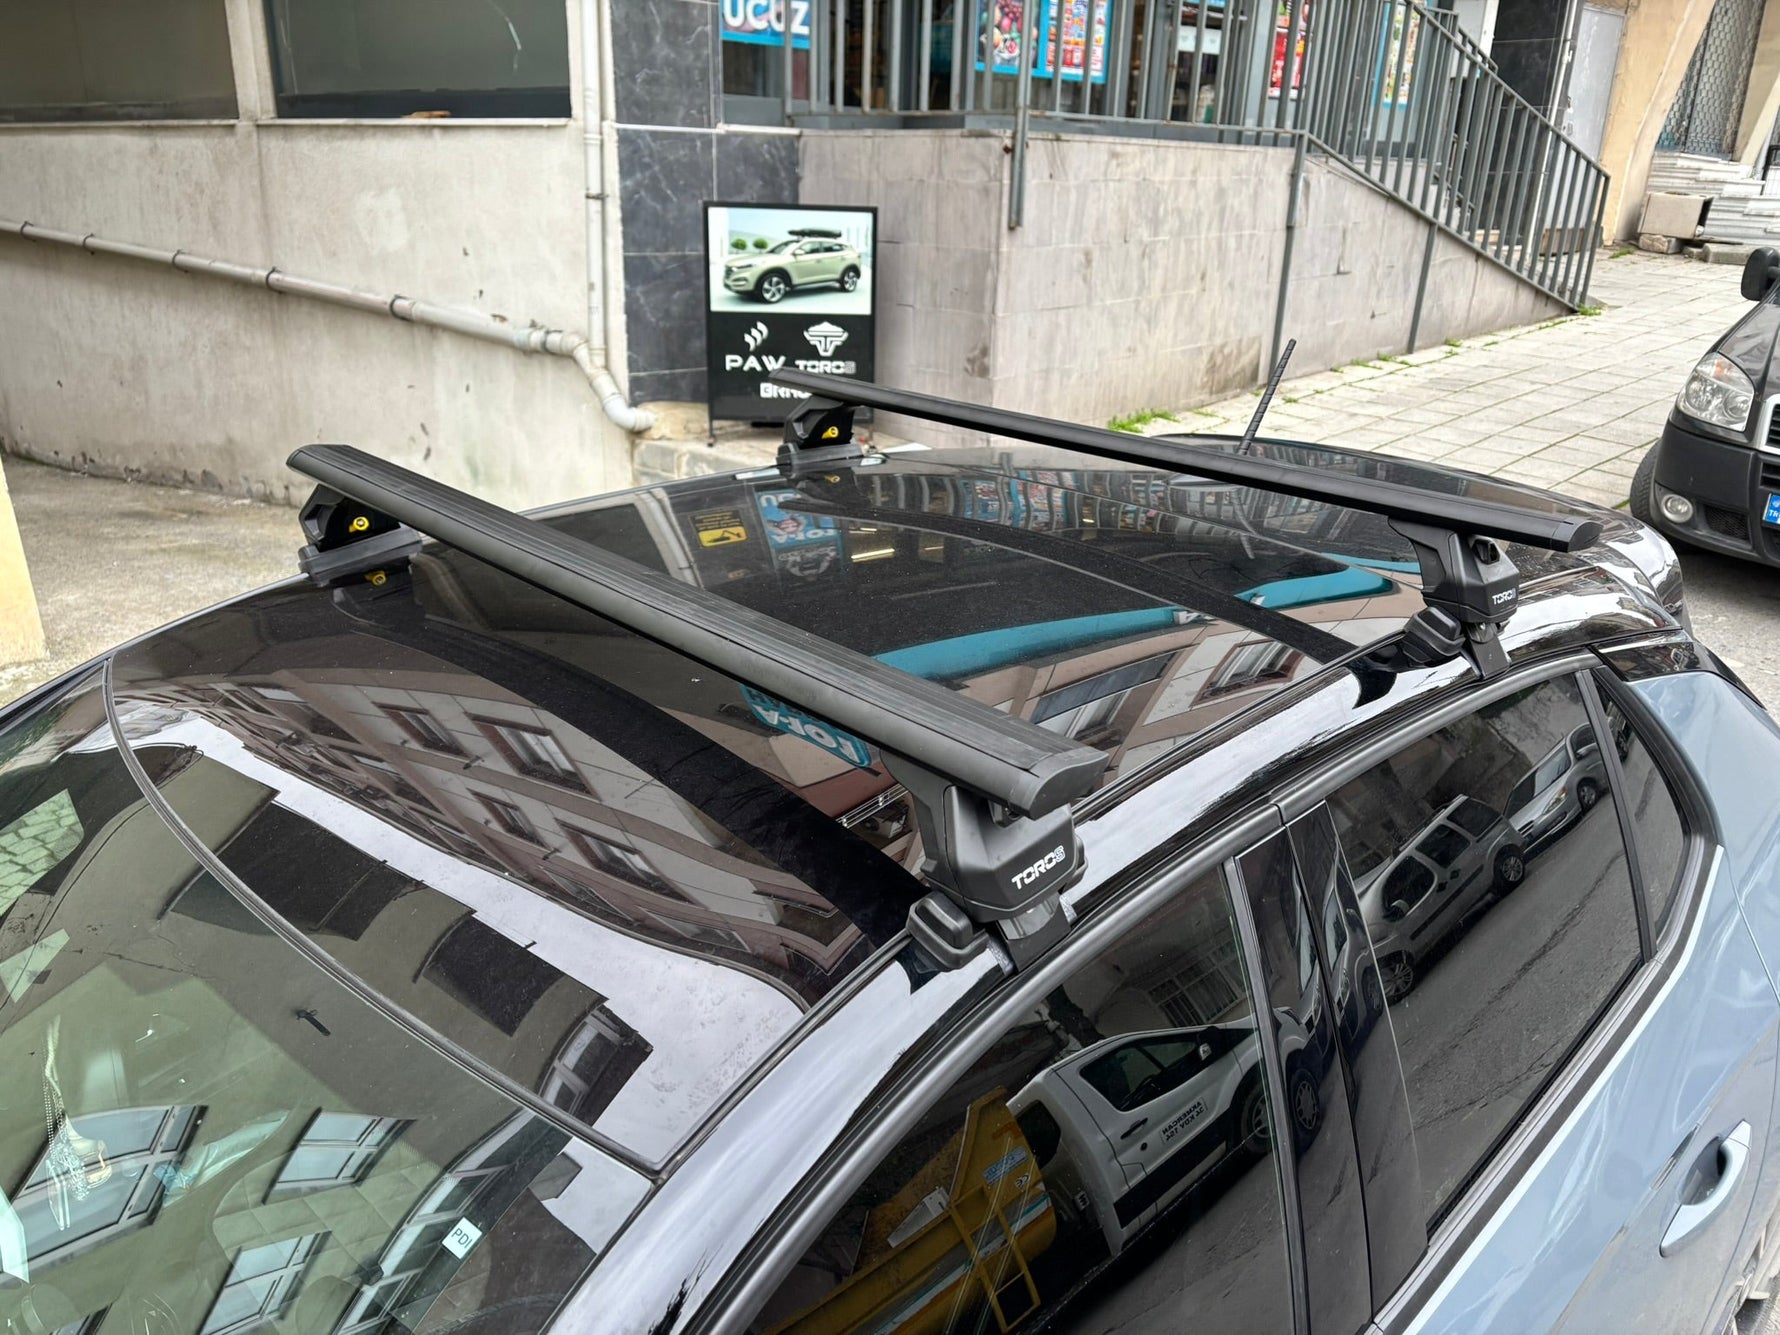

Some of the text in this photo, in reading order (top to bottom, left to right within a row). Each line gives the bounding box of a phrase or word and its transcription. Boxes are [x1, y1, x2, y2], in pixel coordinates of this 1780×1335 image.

[723, 0, 810, 35] UCUZ
[725, 355, 786, 371] PAW
[1011, 845, 1066, 890] TOROS
[451, 1228, 473, 1249] PDI
